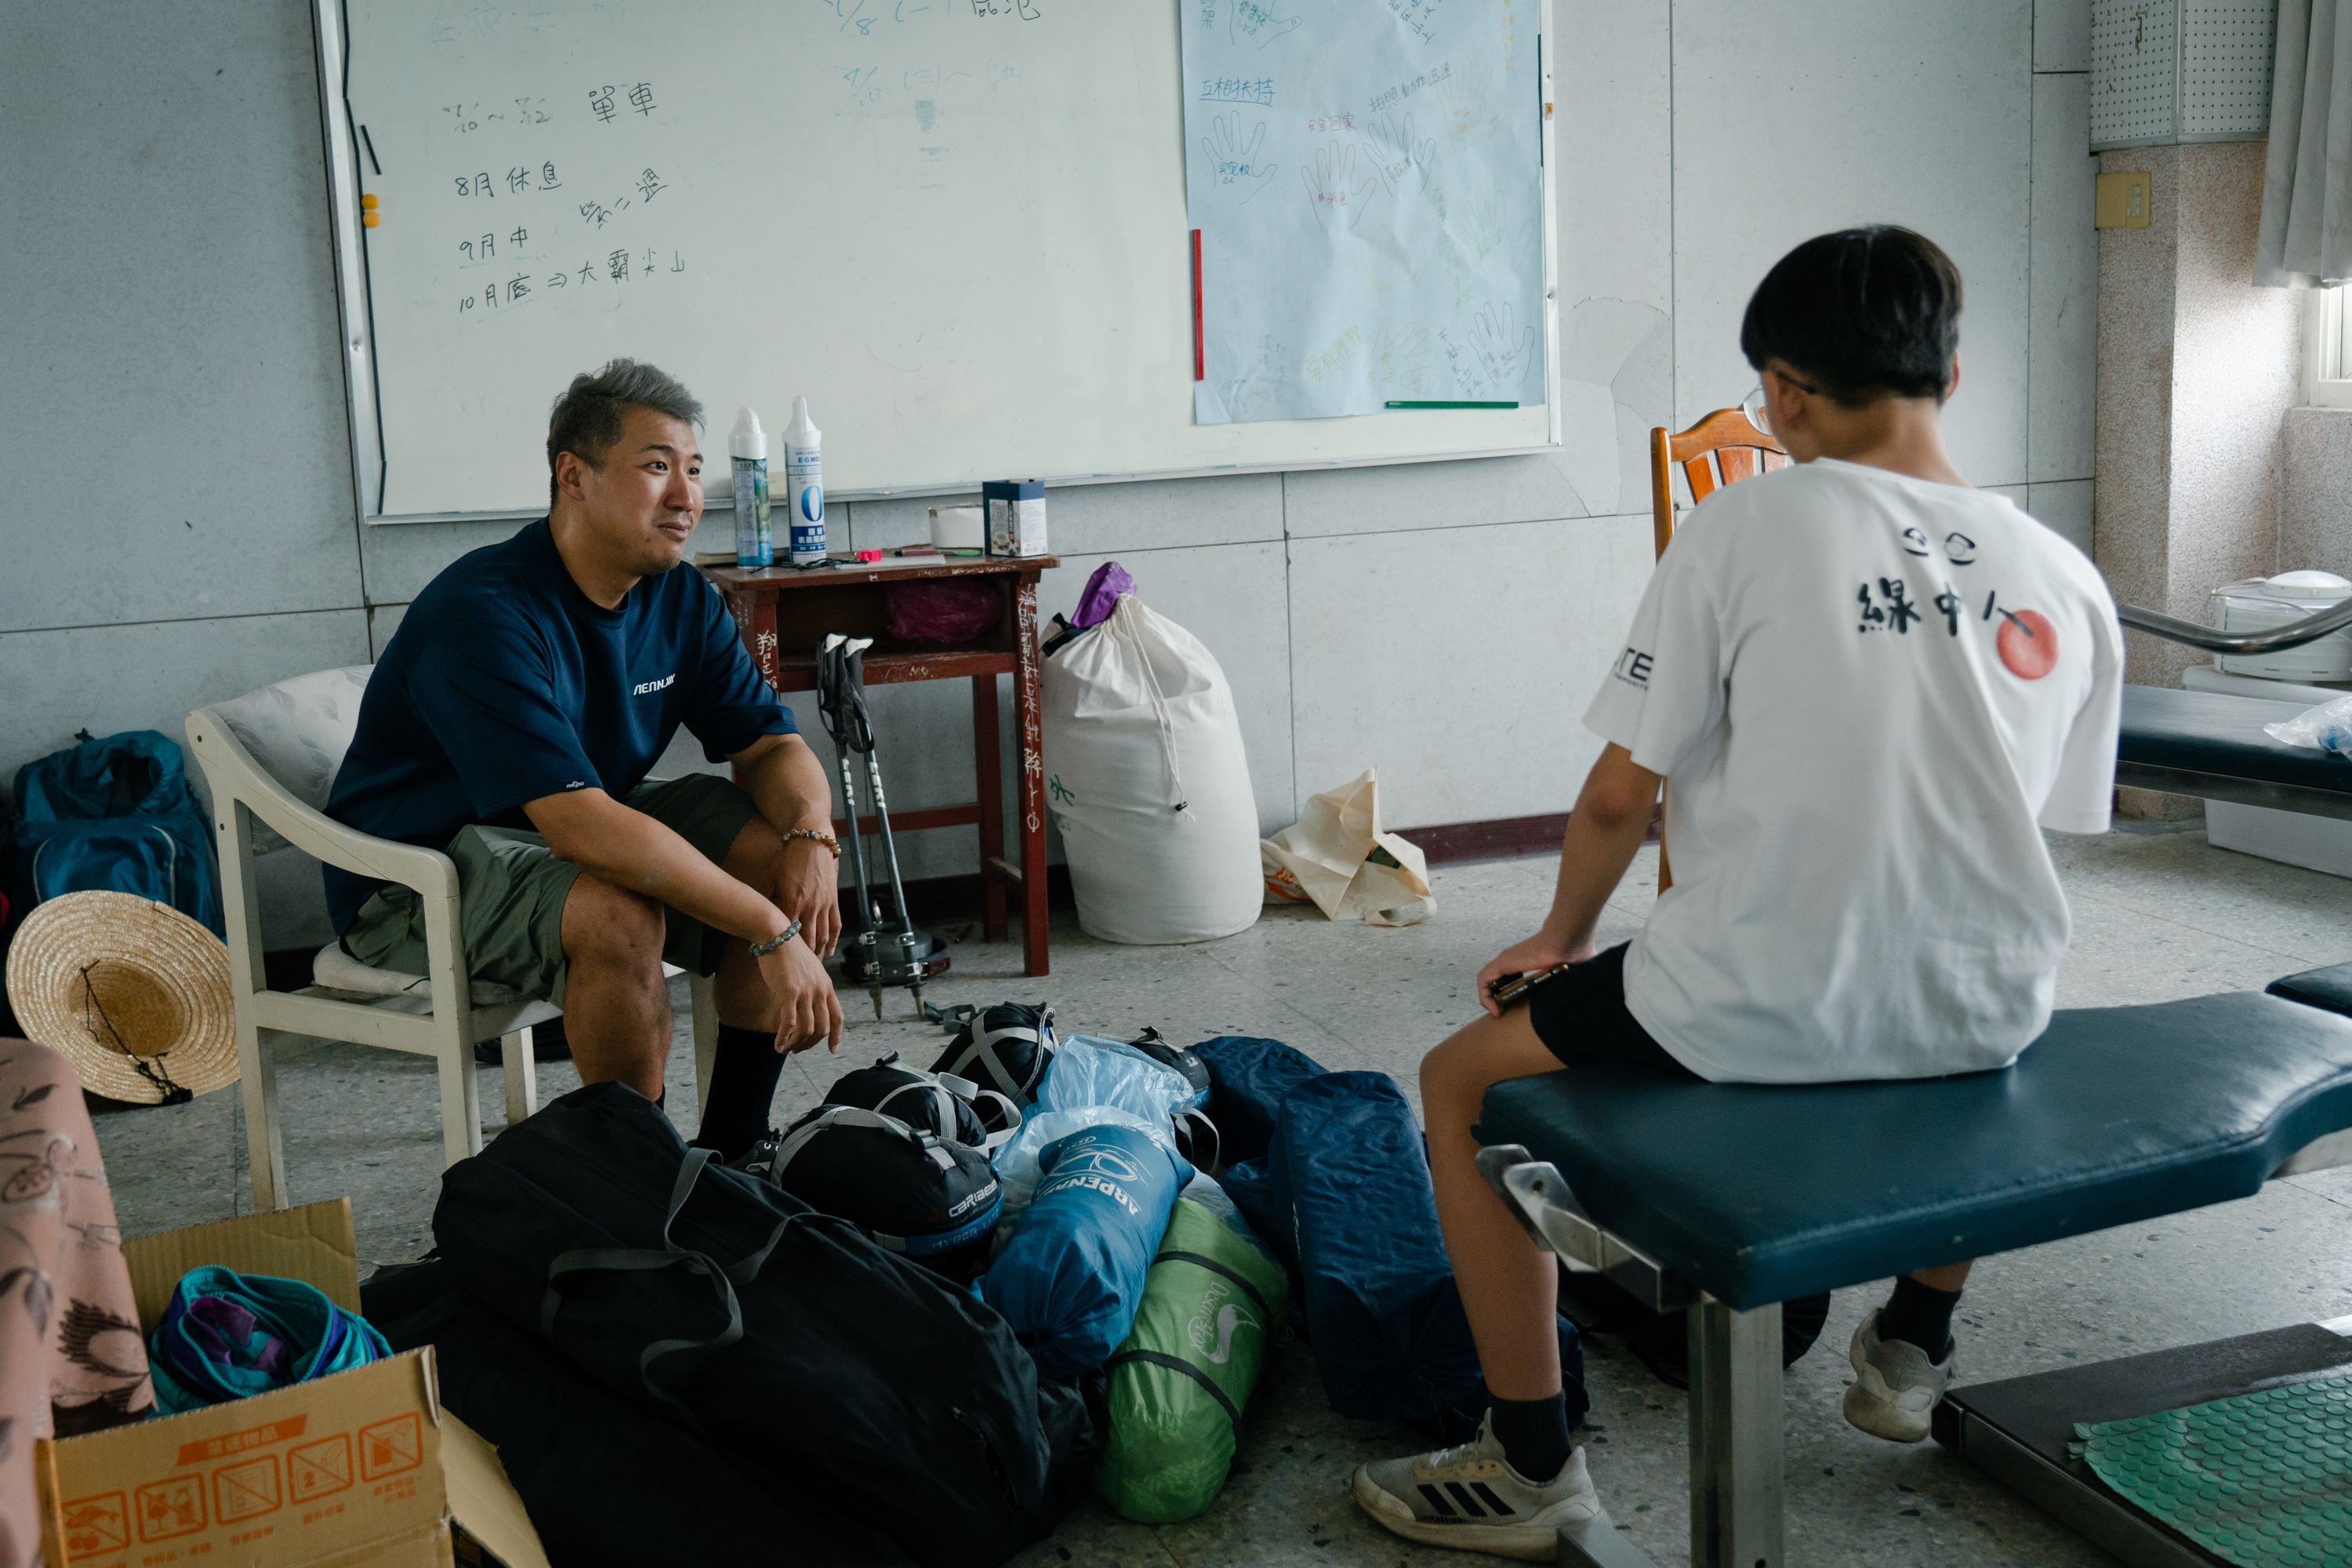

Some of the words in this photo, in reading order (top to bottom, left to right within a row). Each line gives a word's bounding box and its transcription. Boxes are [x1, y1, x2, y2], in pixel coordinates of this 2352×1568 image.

[589, 82, 658, 123] 單車
[1200, 76, 1276, 104] 互相扶持
[1368, 61, 1453, 114] 拍照動作迅速
[1307, 111, 1357, 132] 安全回家
[459, 227, 528, 260] 9月中
[459, 272, 532, 313] 10月底
[579, 248, 685, 285] 大霸尖山
[1044, 1176, 1139, 1215] ARPENA
